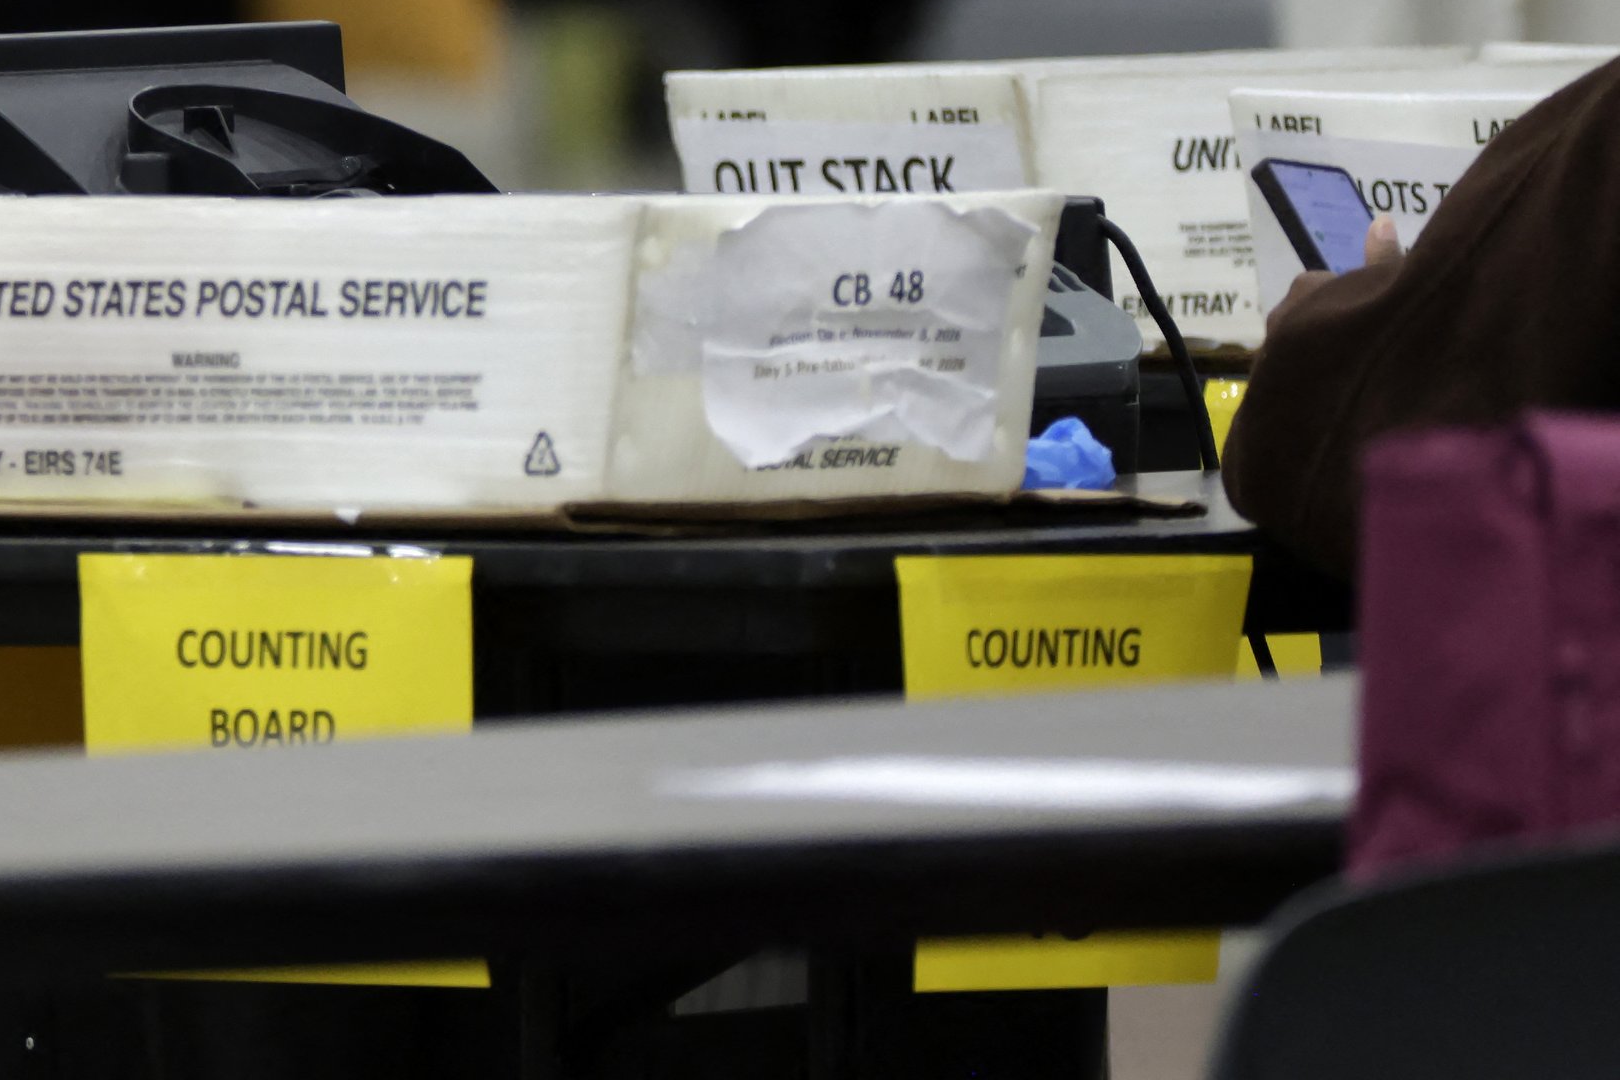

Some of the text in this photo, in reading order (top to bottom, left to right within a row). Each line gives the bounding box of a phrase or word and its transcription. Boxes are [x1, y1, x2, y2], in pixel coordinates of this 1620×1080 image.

[715, 155, 956, 193] OUT STACK
[63, 280, 187, 318] STATES
[196, 279, 329, 318] POSTAL
[338, 279, 487, 318] SERVICE
[833, 270, 925, 306] CB 48
[1181, 291, 1238, 317] TRAY
[172, 352, 241, 368] WARNING
[24, 449, 76, 476] EIRS
[82, 449, 123, 476] 74E
[820, 446, 901, 469] SERVICE
[178, 629, 368, 670] COUNTING
[967, 627, 1142, 668] COUNTING
[210, 708, 336, 748] BOARD
